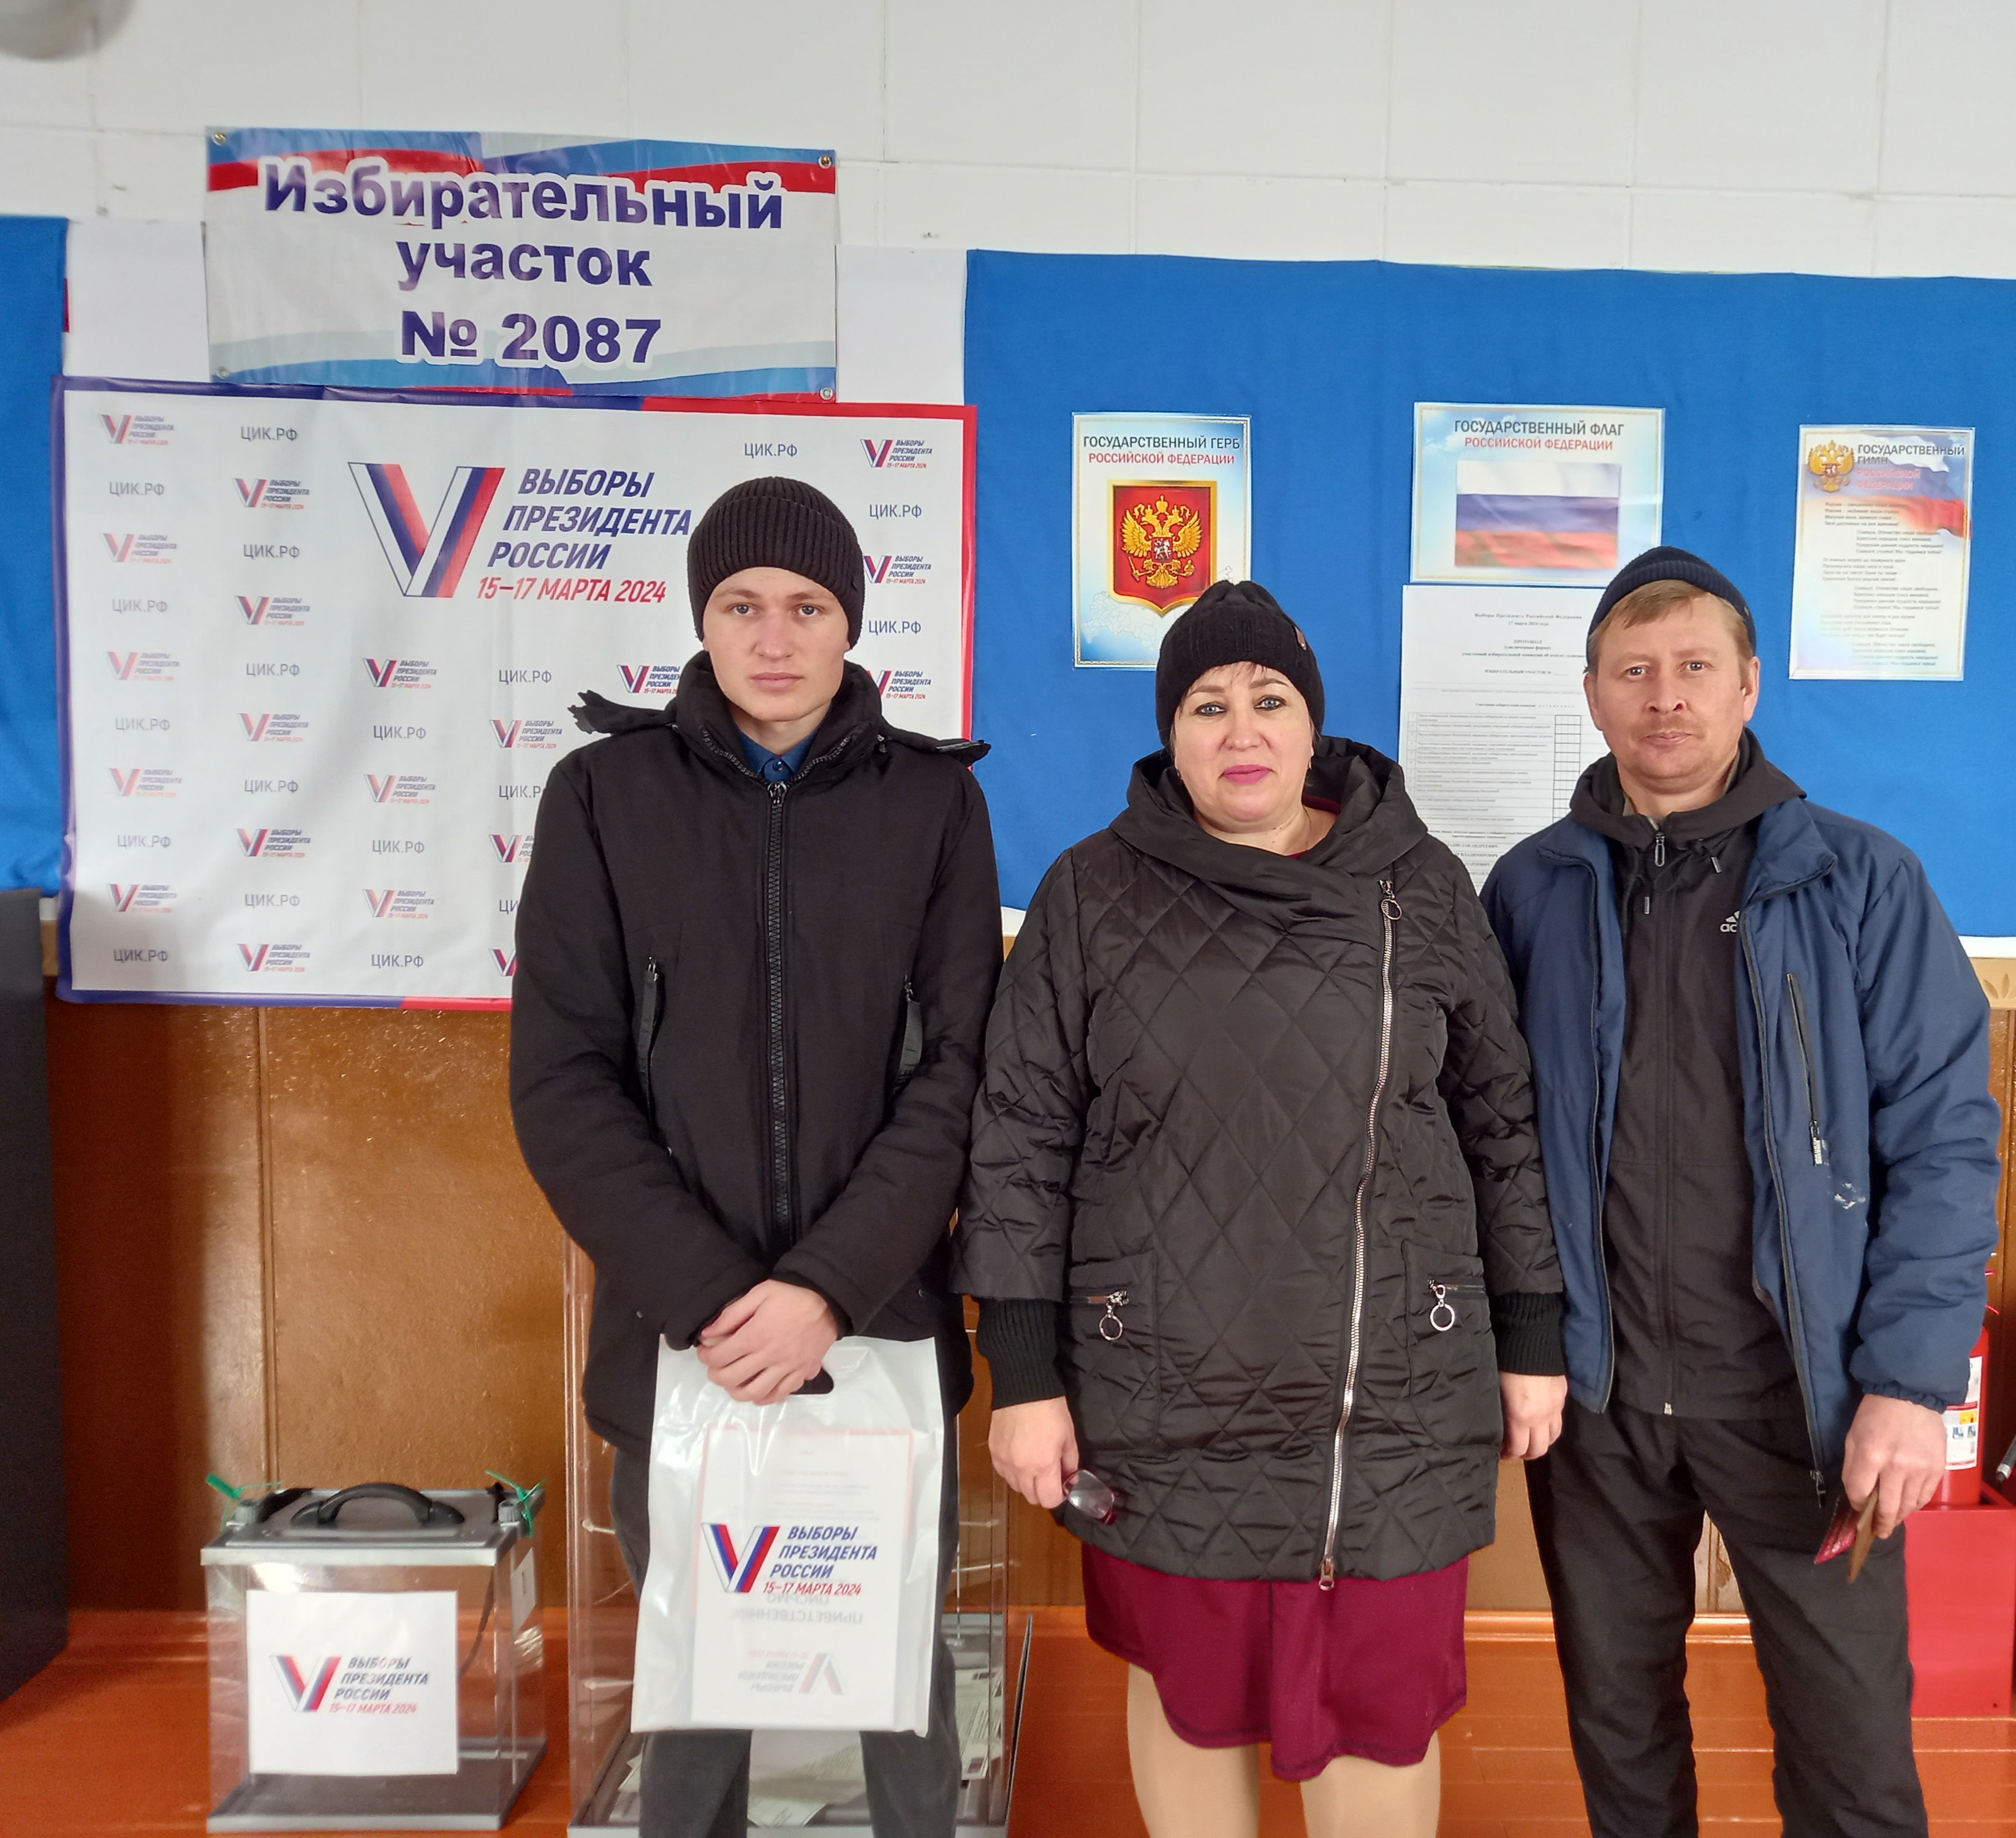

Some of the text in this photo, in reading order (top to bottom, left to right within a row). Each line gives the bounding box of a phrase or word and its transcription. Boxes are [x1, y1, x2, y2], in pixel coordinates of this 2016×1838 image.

[265, 164, 783, 229] Избирательный
[396, 241, 652, 290] участок
[402, 311, 661, 363] № 2087
[241, 426, 297, 442] ЦИК.РФ
[1455, 420, 1624, 436] ГОСУДАРСТВЕННЫЙ ФЛАГ
[1084, 436, 1240, 449] ГОСУДАРСТВЕННЫЙ ГЕРБ
[1465, 437, 1612, 451] РОССИЙСКОЙ ФЕДЕРАЦИИ
[1857, 444, 1965, 456] ГОСУДАРСТВЕННЫЙ
[745, 443, 797, 458] ЦИК.РФ
[1089, 452, 1234, 465] РОССИЙСКОЙ ФЕДЕРАЦИИ
[1857, 456, 1889, 465] ГИМН
[110, 482, 164, 497] ЦИК.РФ
[518, 468, 655, 497] ВЫБОРЫ
[870, 504, 922, 520] ЦИК.РФ
[503, 505, 692, 537] ПРЕЗИДЕНТА
[244, 545, 300, 559] ЦИК.РФ
[487, 542, 612, 569] РОССИИ
[537, 578, 611, 602] МАРТА
[614, 580, 667, 603] 2024
[113, 599, 167, 614] ЦИК.РФ
[869, 621, 921, 635] ЦИК.РФ
[246, 664, 300, 678] ЦИК.РФ
[499, 670, 551, 685] ЦИК.РФ
[115, 718, 171, 732] ЦИК.РФ
[374, 725, 426, 740] ЦИК.РФ
[244, 780, 298, 794] ЦИК.РФ
[499, 785, 546, 799] ЦИК.Р
[118, 835, 170, 849] ЦИК.РФ
[373, 840, 424, 855] ЦИК.РФ
[245, 894, 300, 909] ЦИК.РФ
[114, 950, 168, 963] ЦИК.РФ
[372, 954, 423, 969] ЦИК.РФ
[787, 1526, 858, 1541] ВЫБОРЫ
[778, 1545, 876, 1562] ПРЕЗИДЕНТА
[769, 1564, 835, 1578] РОССИИ
[794, 1583, 833, 1595] МАРТА
[833, 1583, 861, 1595] 2024
[347, 1657, 411, 1670] ВЫБОРЫ
[341, 1673, 428, 1686] ПРЕЗИДЕНТА
[334, 1688, 392, 1700] РОССИИ
[357, 1703, 391, 1713] МАРТА
[392, 1703, 416, 1714] 2024
